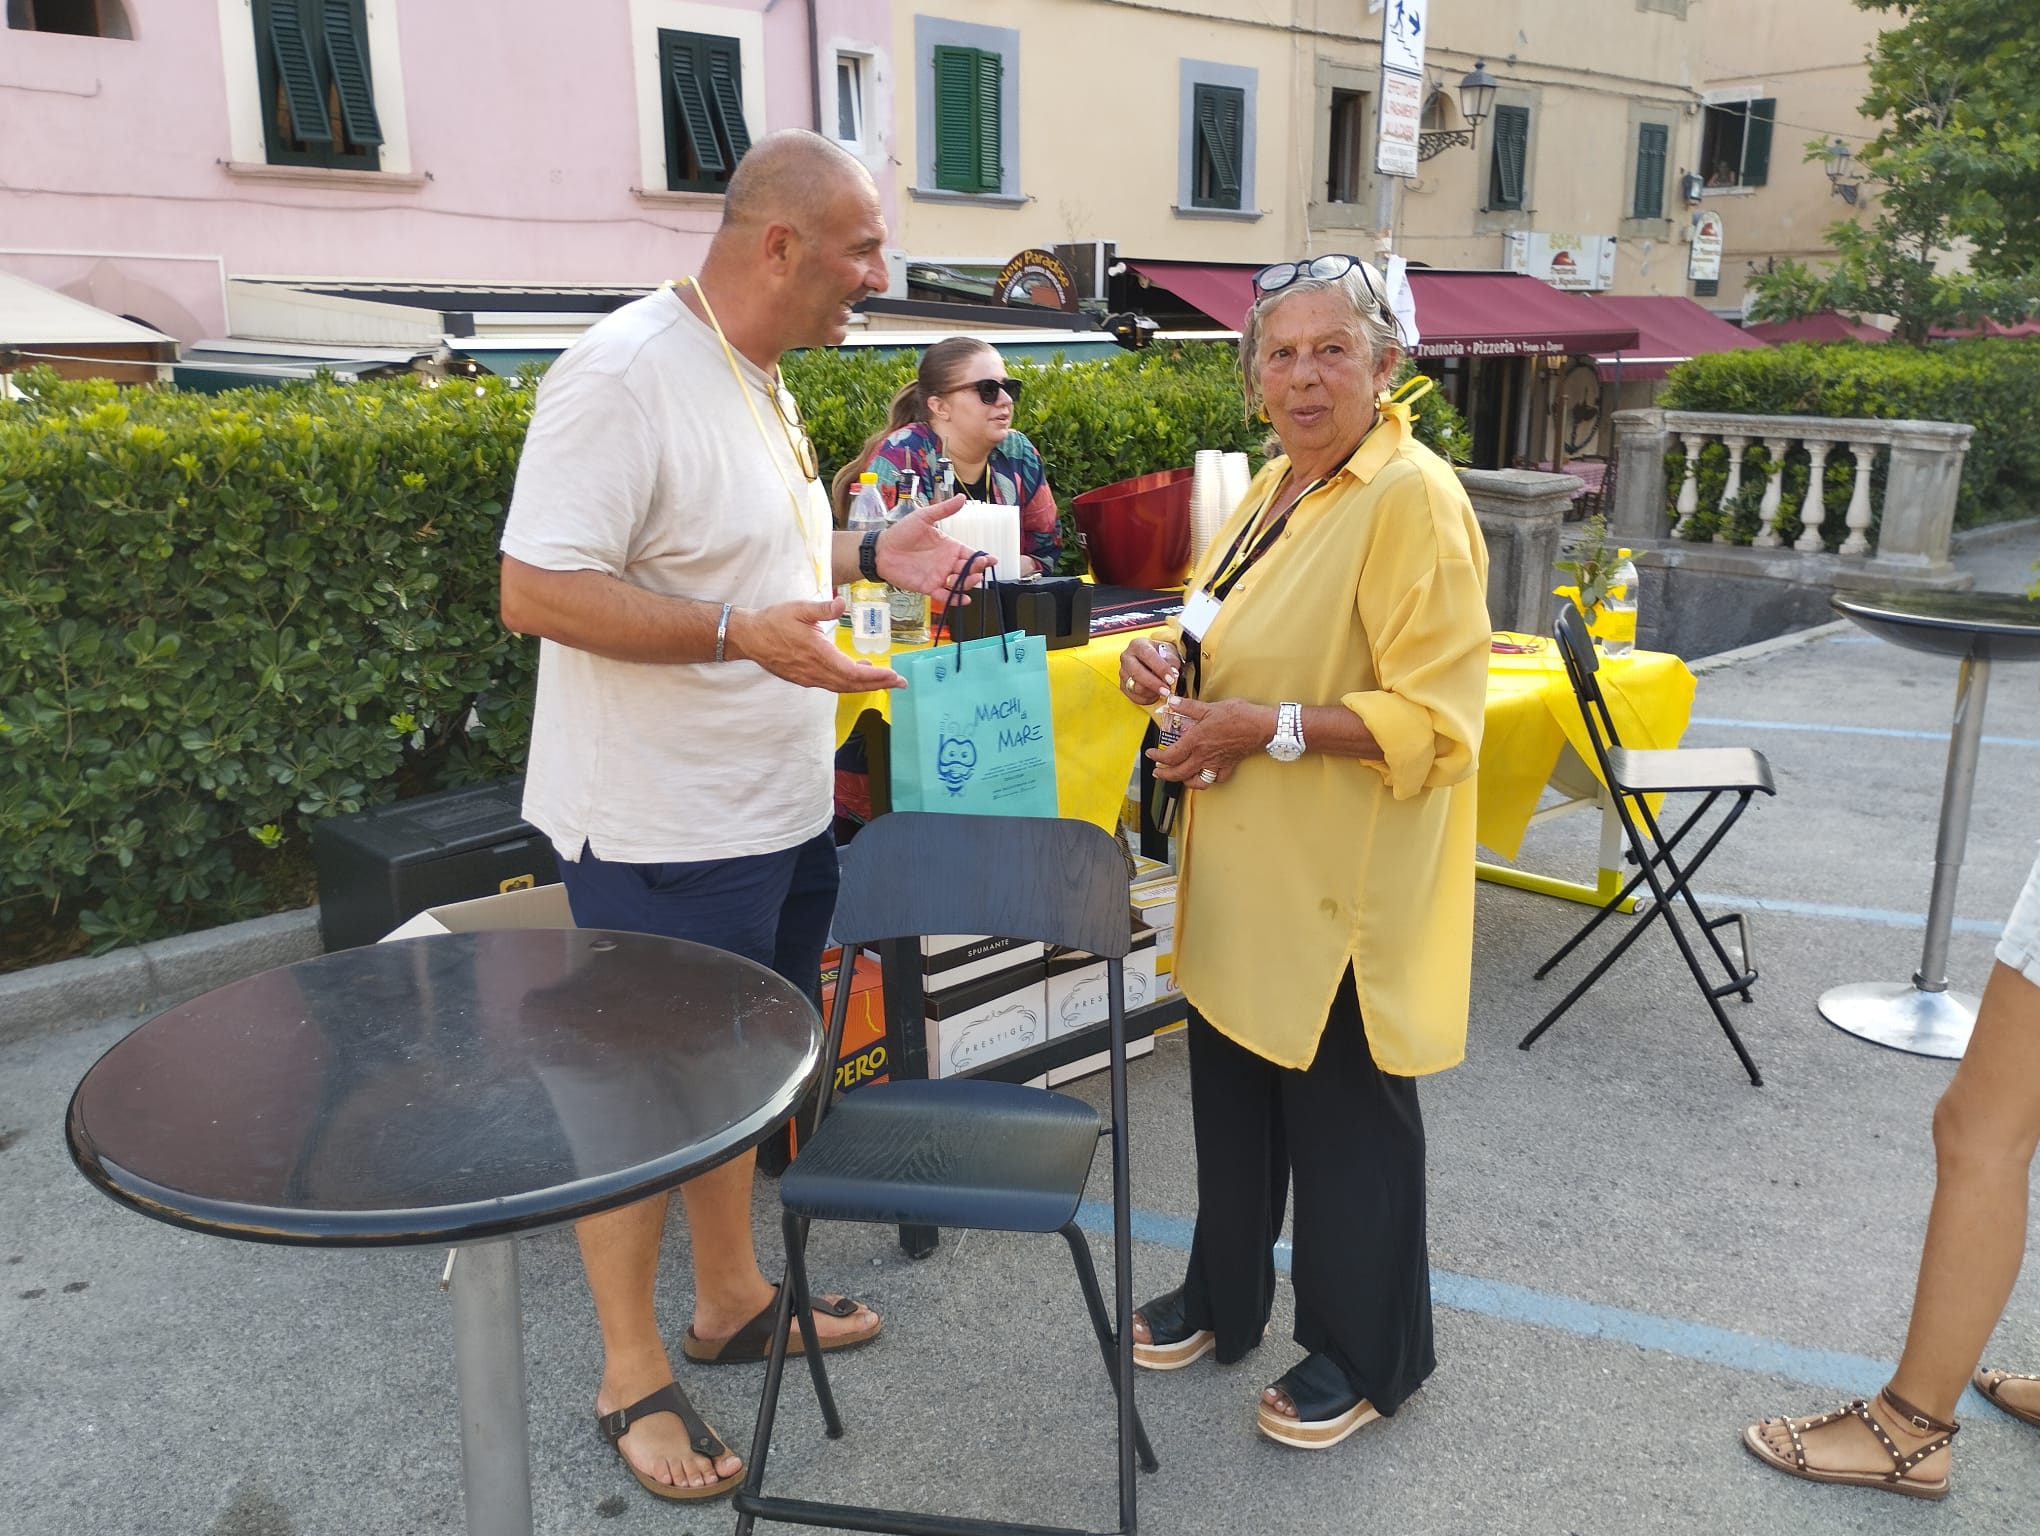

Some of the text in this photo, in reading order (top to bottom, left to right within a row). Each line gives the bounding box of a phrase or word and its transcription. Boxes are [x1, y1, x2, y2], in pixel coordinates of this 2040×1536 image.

[997, 258, 1023, 289] New
[1024, 250, 1070, 288] Paradise
[1418, 340, 1464, 356] Trattoria
[1472, 339, 1515, 355] Pizzeria
[998, 725, 1043, 752] MARE
[967, 938, 1009, 957] SPUMANTE
[965, 1024, 1025, 1054] PRESTIGE
[833, 1046, 888, 1090] PERO
